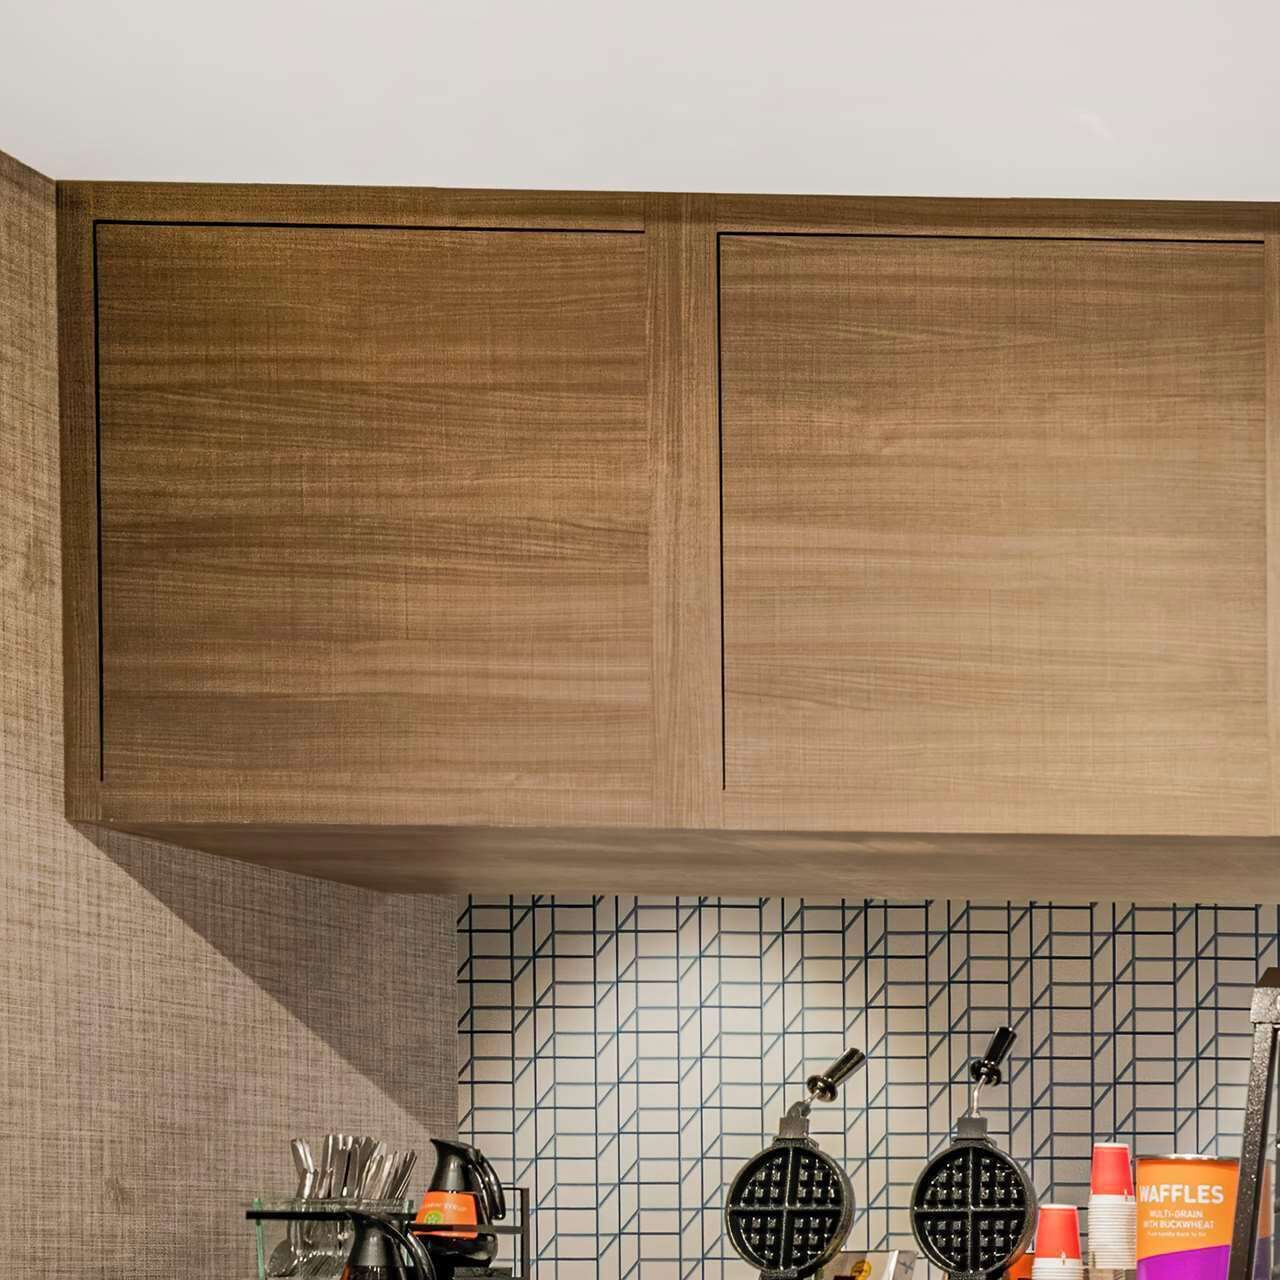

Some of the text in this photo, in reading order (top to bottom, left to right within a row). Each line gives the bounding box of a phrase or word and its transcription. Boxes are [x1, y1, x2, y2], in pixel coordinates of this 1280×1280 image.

[1139, 1183, 1225, 1204] WAFFLES
[1149, 1208, 1204, 1219] MULTI-GRAIN
[1159, 1220, 1215, 1230] BUCKWHEAT
